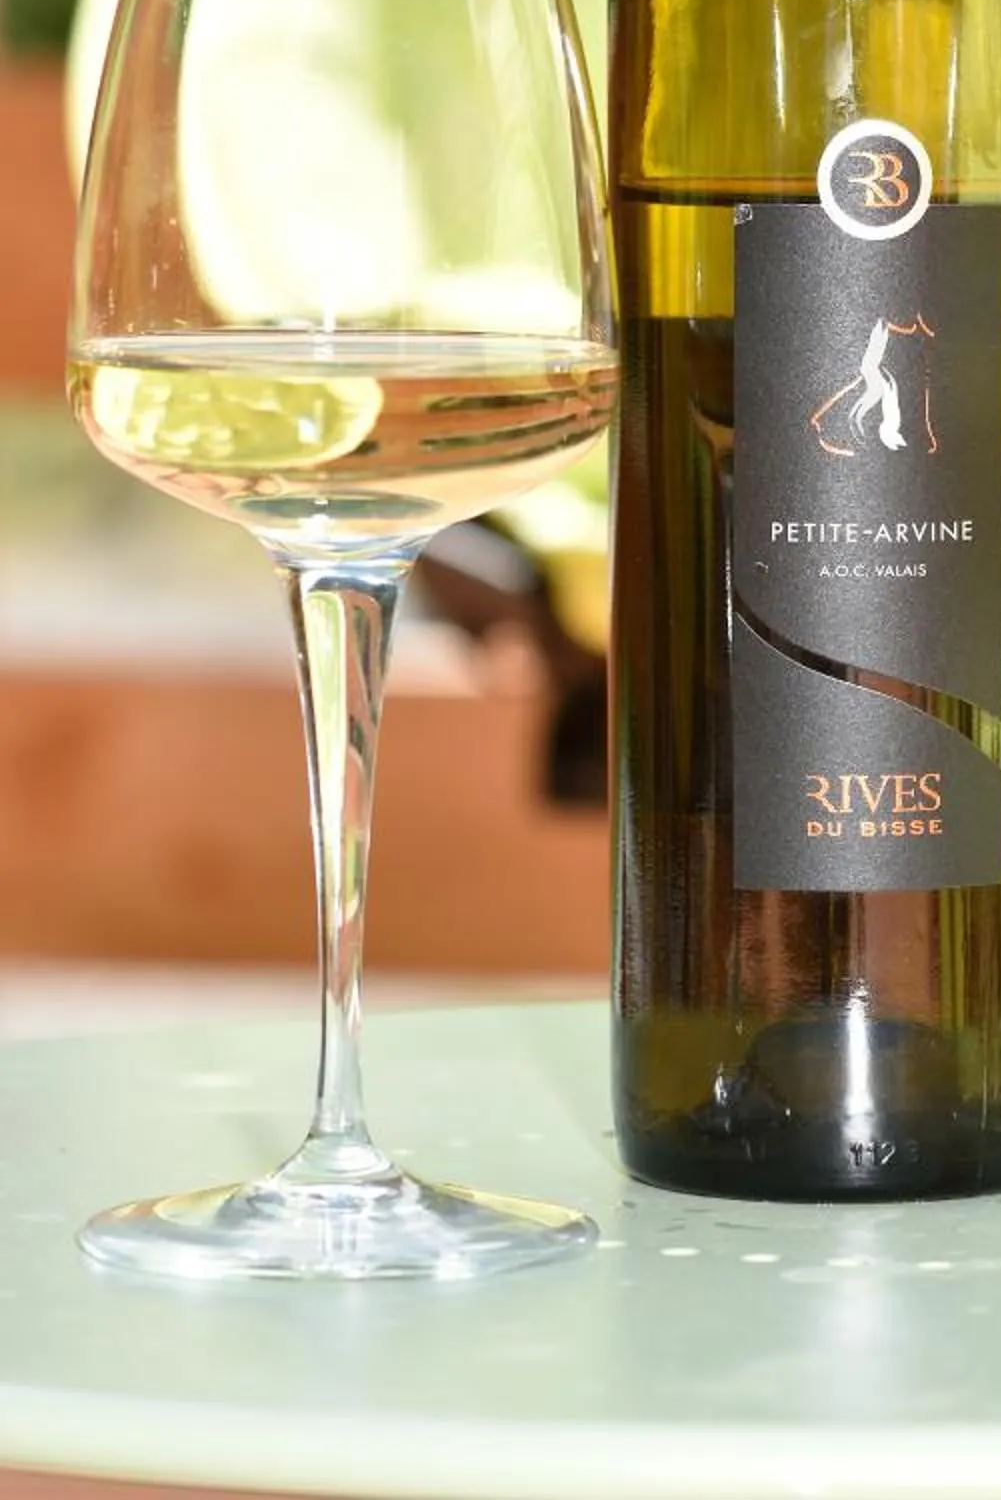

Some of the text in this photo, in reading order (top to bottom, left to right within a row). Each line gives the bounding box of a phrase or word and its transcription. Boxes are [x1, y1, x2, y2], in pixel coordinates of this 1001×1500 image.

[771, 520, 974, 543] PETITE-ARVINE
[876, 564, 928, 577] VALAIS
[806, 773, 942, 813] RIVES
[807, 819, 943, 837] DU BISSE
